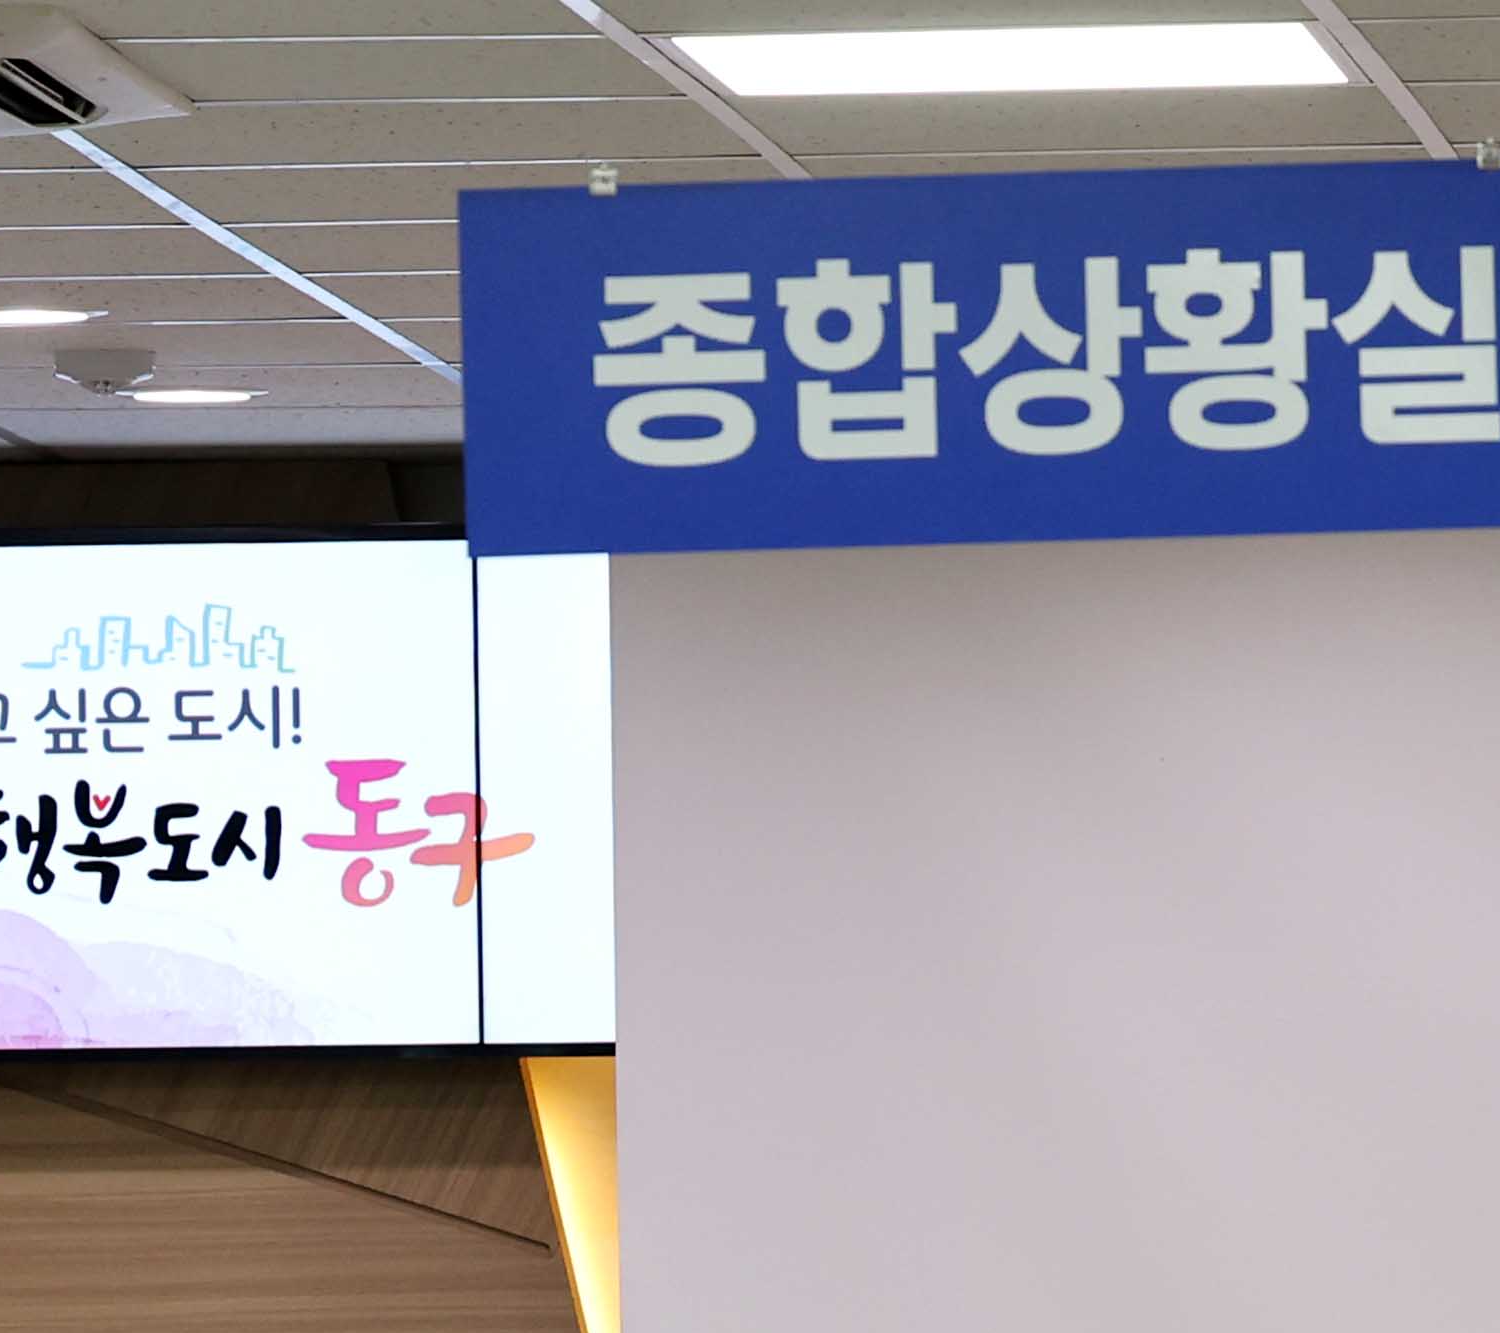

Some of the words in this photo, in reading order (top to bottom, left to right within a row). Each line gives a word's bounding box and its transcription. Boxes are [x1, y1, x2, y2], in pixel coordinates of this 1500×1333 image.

[33, 686, 151, 755] 싶은
[167, 684, 303, 750] 도시!
[301, 758, 537, 909] 동구
